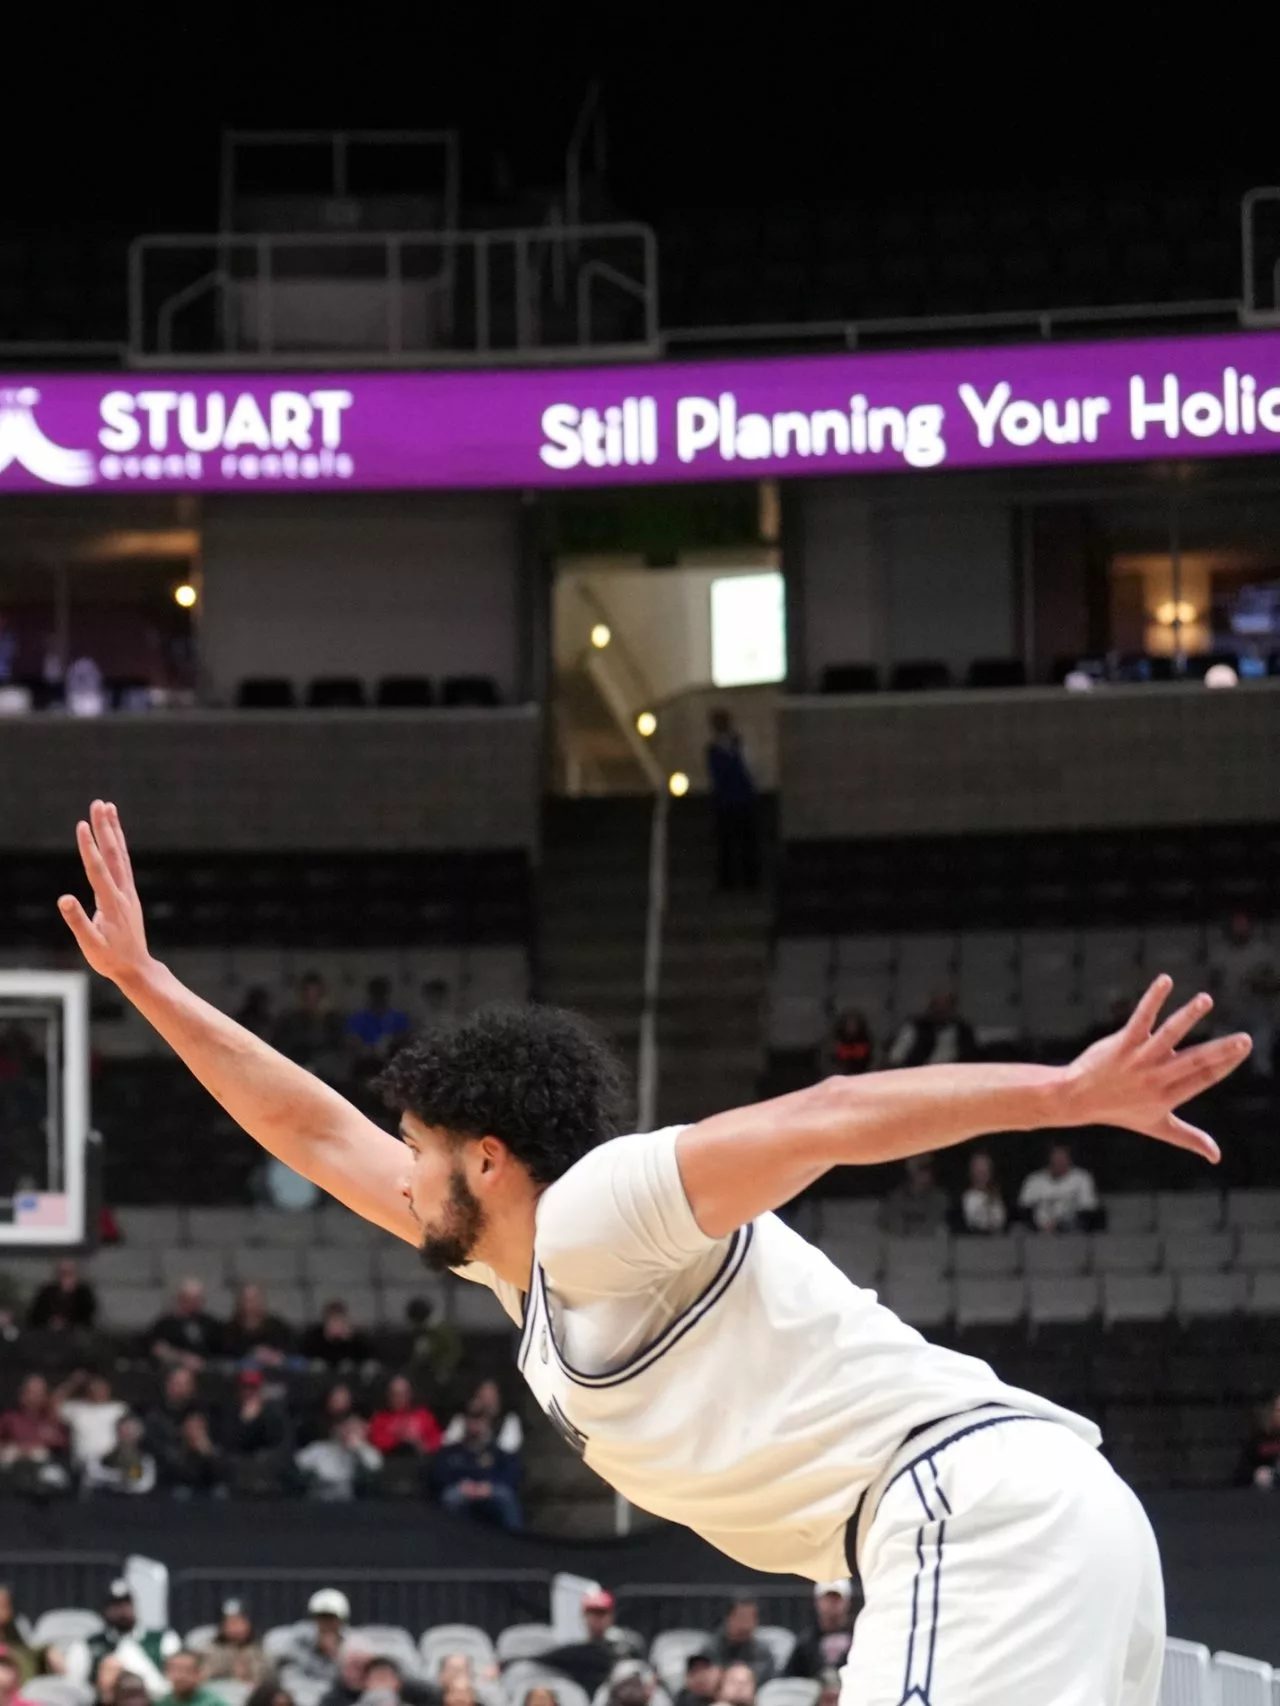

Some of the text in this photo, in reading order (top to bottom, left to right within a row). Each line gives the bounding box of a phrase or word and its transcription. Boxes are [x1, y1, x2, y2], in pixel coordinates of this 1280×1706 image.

[98, 390, 353, 452] STUART
[540, 396, 657, 469] Still
[677, 392, 945, 467] Planning
[959, 381, 1109, 448] Your
